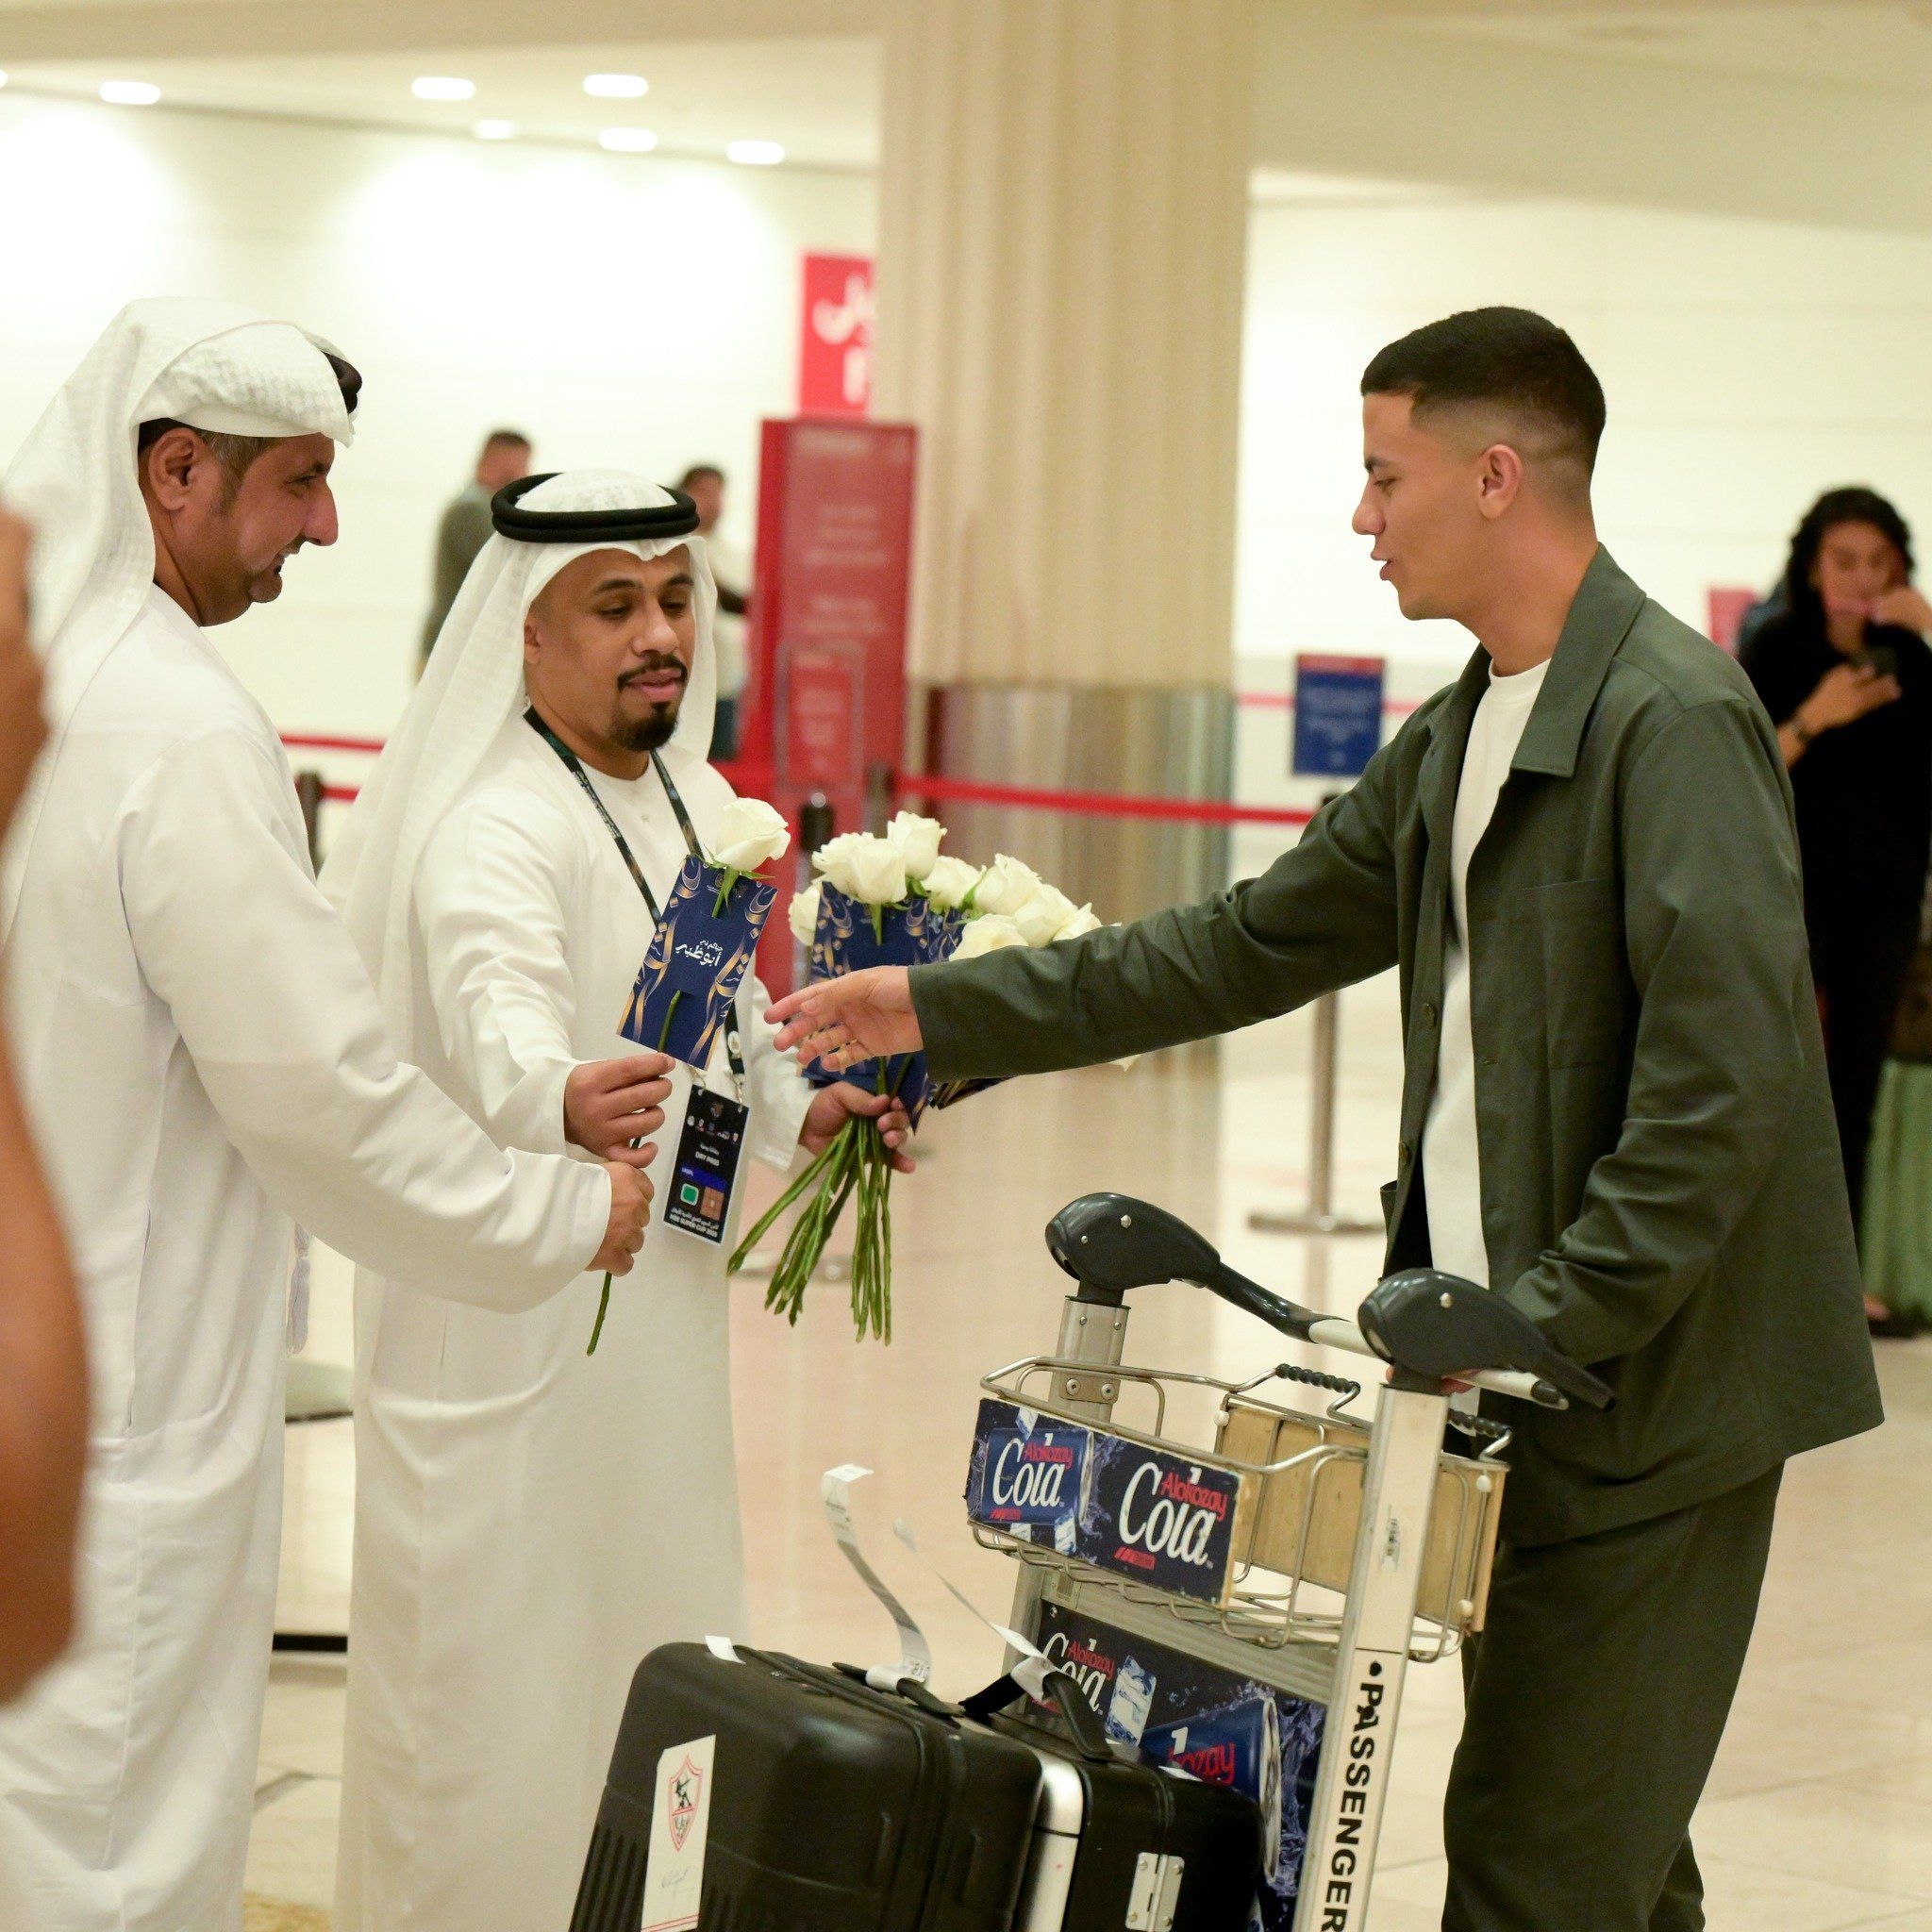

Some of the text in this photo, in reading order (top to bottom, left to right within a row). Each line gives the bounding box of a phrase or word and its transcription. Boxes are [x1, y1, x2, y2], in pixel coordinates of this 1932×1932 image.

[675, 943, 722, 967] أبوظبي
[992, 1433, 1065, 1507] Cola
[1160, 1470, 1229, 1522] Alokozay
[1119, 1462, 1217, 1567] Cola
